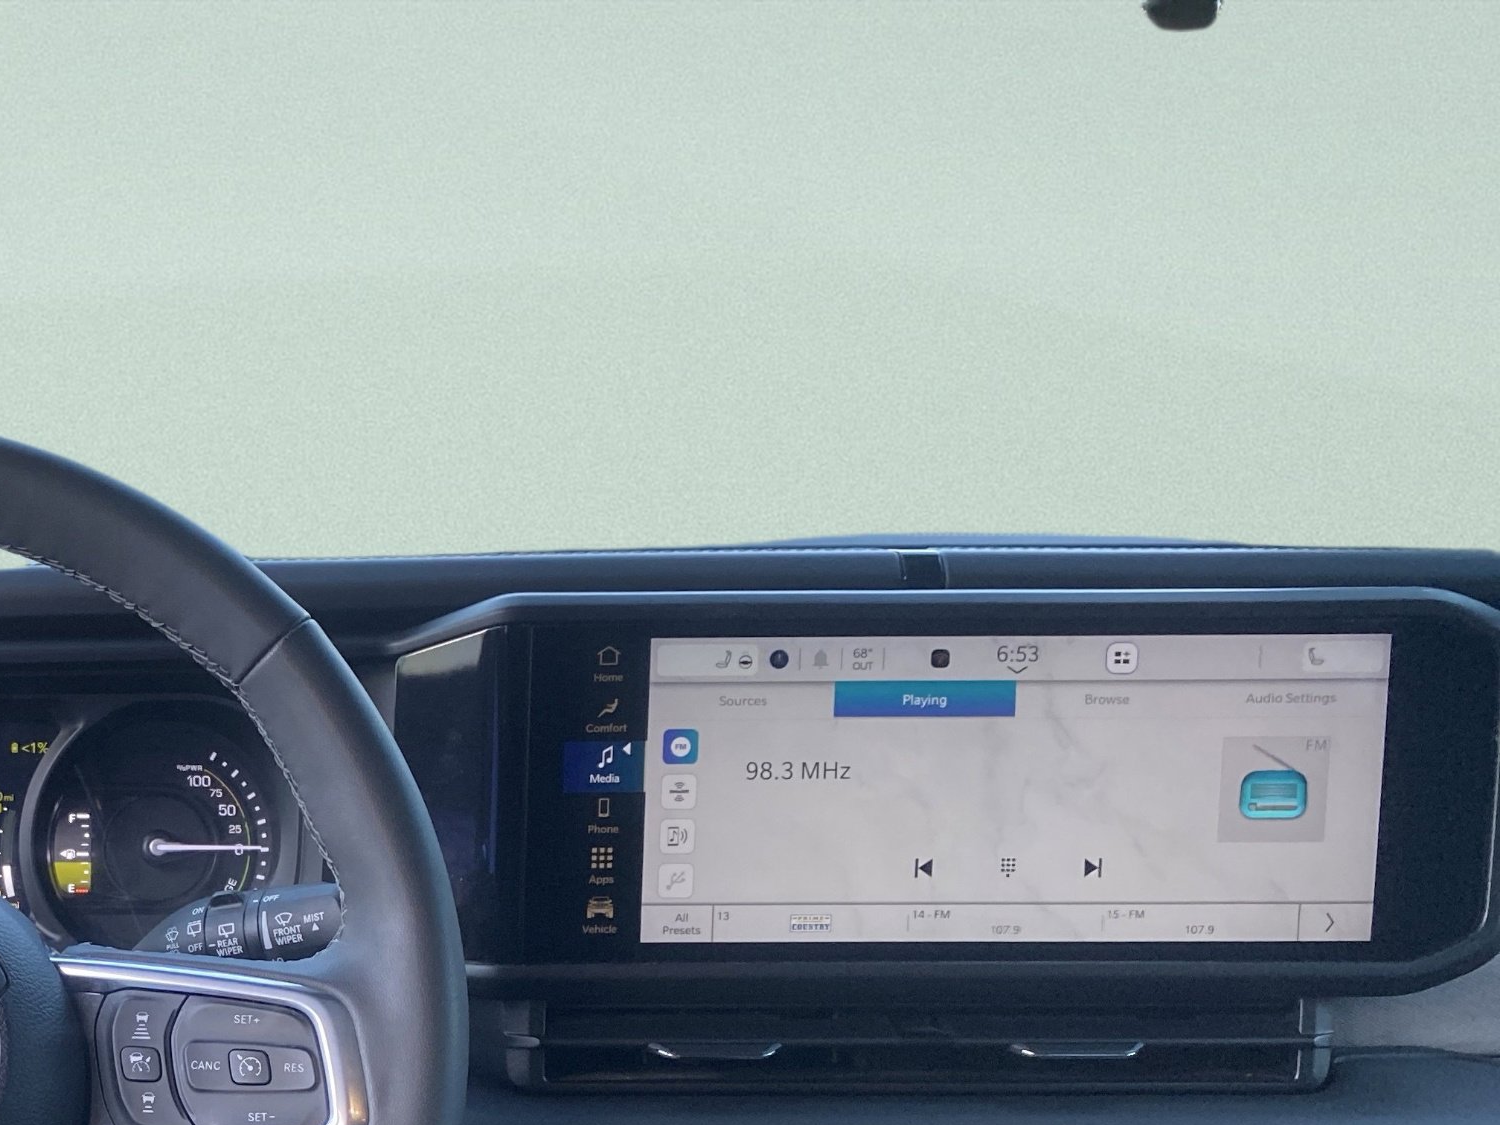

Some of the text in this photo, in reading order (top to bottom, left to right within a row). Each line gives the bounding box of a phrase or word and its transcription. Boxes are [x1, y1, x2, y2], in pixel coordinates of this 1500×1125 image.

[996, 645, 1040, 663] 6:53
[852, 661, 874, 671] OUT
[593, 672, 624, 683] Home
[718, 695, 768, 708] Sources
[902, 693, 948, 709] Playing
[1083, 693, 1130, 706] Browse
[1245, 691, 1338, 707] Audio Settings
[585, 722, 628, 734] Comfort
[674, 743, 688, 751] FM
[1305, 739, 1328, 751] FM
[745, 761, 852, 782] 98.3 MHz
[187, 775, 211, 788] 100
[589, 773, 621, 785] Media
[209, 788, 223, 798] 75
[218, 804, 236, 817] 50
[68, 814, 77, 824] F
[228, 825, 242, 834] 25
[587, 824, 619, 835] Phone
[588, 874, 615, 887] Apps
[67, 884, 76, 894] E
[263, 894, 280, 903] OFF
[192, 906, 205, 916] ON
[717, 911, 730, 921] 13
[912, 910, 925, 919] 14
[933, 910, 951, 919] FM
[1107, 909, 1120, 919] 15
[1128, 909, 1146, 919] FM
[303, 911, 325, 924] MIST
[674, 912, 689, 923] All
[272, 924, 302, 937] FRONT
[582, 923, 618, 935] Vehicle
[662, 925, 702, 937] Presets
[991, 925, 1022, 935] 107.9
[1184, 924, 1215, 936] 107.9
[217, 937, 239, 948] REAR
[275, 933, 304, 946] WIPER
[187, 943, 203, 953] OFF
[215, 945, 244, 957] WIPER
[190, 1060, 221, 1072] CANC
[283, 1062, 305, 1073] RES
